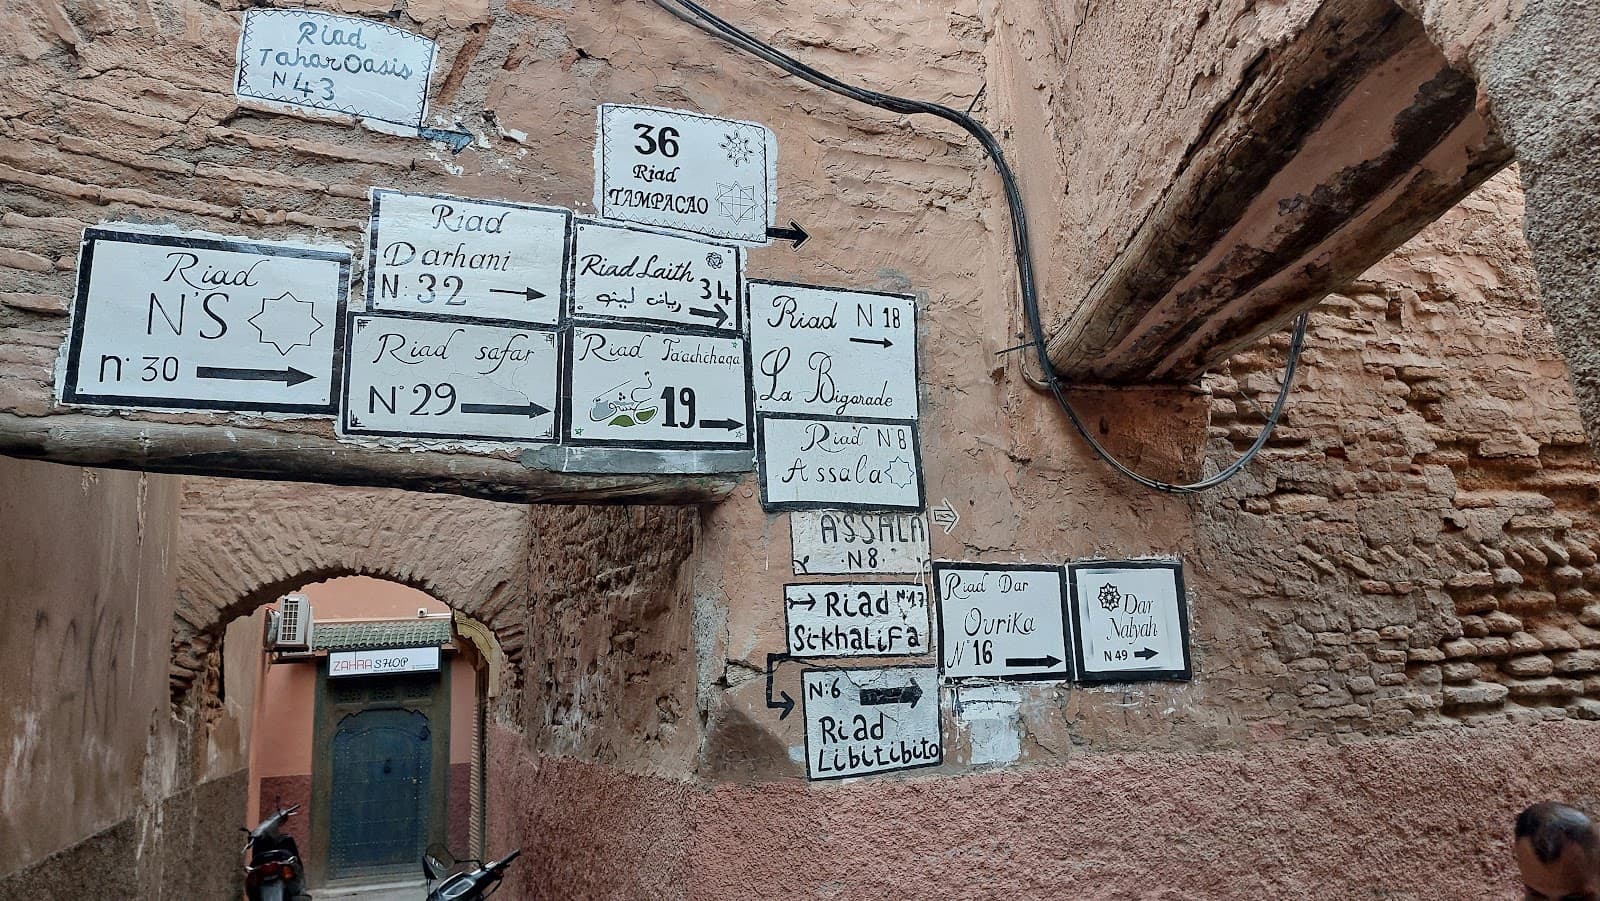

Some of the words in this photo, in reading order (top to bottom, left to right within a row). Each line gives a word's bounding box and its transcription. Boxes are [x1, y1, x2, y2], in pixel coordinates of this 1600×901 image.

[297, 21, 366, 50] Riad
[633, 123, 680, 158] 36
[633, 164, 681, 183] Riad
[609, 187, 709, 215] TAMPACAO
[432, 204, 511, 234] Riad
[163, 252, 270, 290] Riad
[383, 241, 511, 272] Darhani
[580, 253, 636, 277] Riad
[636, 254, 695, 283] Laith
[700, 278, 732, 306] 34
[767, 295, 838, 330] Riad
[882, 307, 901, 329] 18
[372, 328, 465, 365] Riad
[475, 333, 534, 375] safar
[579, 333, 651, 362] Riad
[141, 356, 179, 382] 30
[759, 346, 793, 401] La
[804, 351, 893, 415] Bigarade
[660, 386, 696, 429] 19
[800, 423, 868, 453] Riad
[782, 454, 883, 483] Assala
[820, 514, 925, 545] ASSALA
[943, 572, 989, 601] Riad
[998, 574, 1029, 594] Dar
[824, 590, 889, 617] Riad
[1120, 593, 1154, 615] Dar
[1106, 615, 1158, 645] Nalyah
[333, 659, 373, 672] ZAHRA
[373, 657, 409, 669] SHOP
[818, 712, 884, 745] Riad
